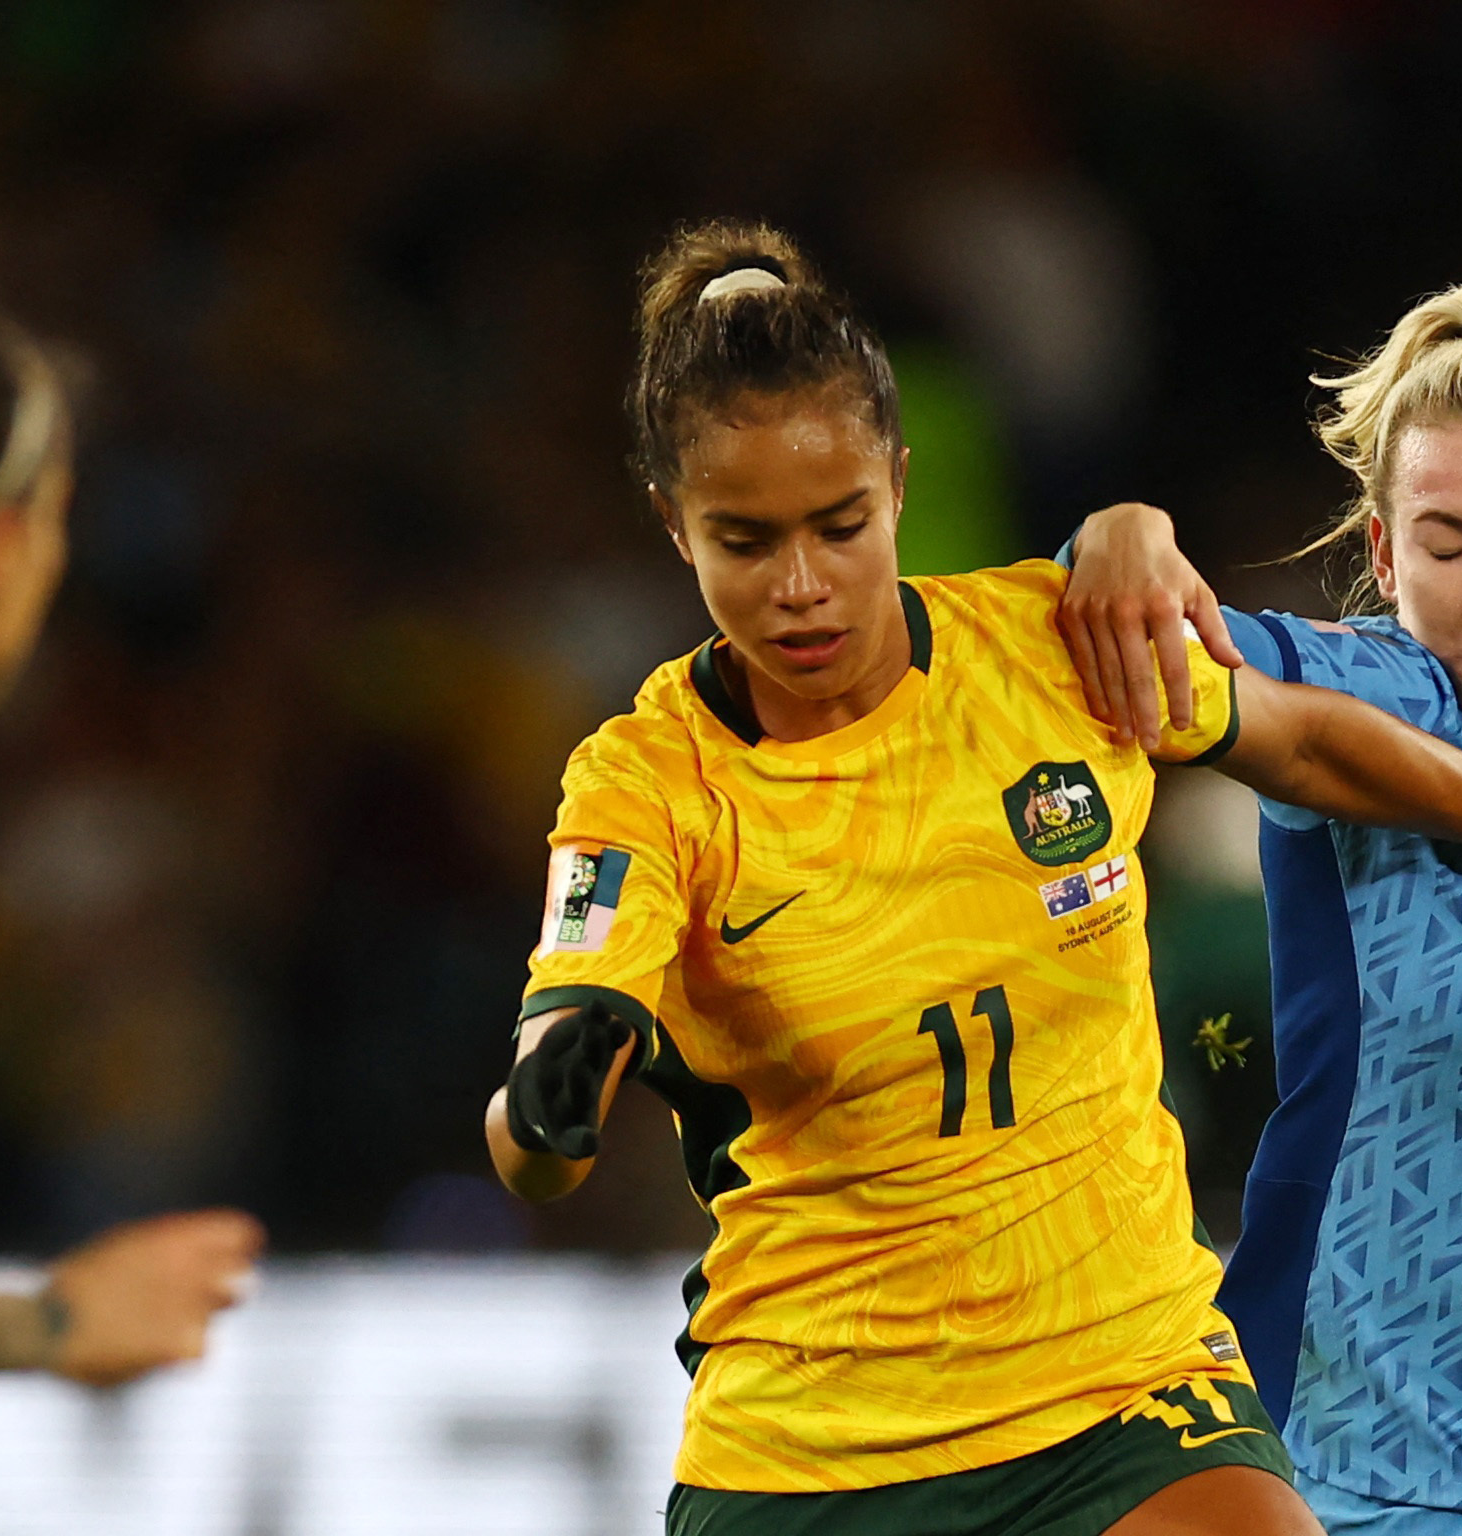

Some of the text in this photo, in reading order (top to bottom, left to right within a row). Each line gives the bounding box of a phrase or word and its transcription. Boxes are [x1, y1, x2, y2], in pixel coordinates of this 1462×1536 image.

[1035, 816, 1096, 847] AUSTRALIA
[1078, 909, 1111, 932] AUGUST
[1058, 932, 1098, 953] SYDNEY,
[917, 984, 1017, 1138] 11
